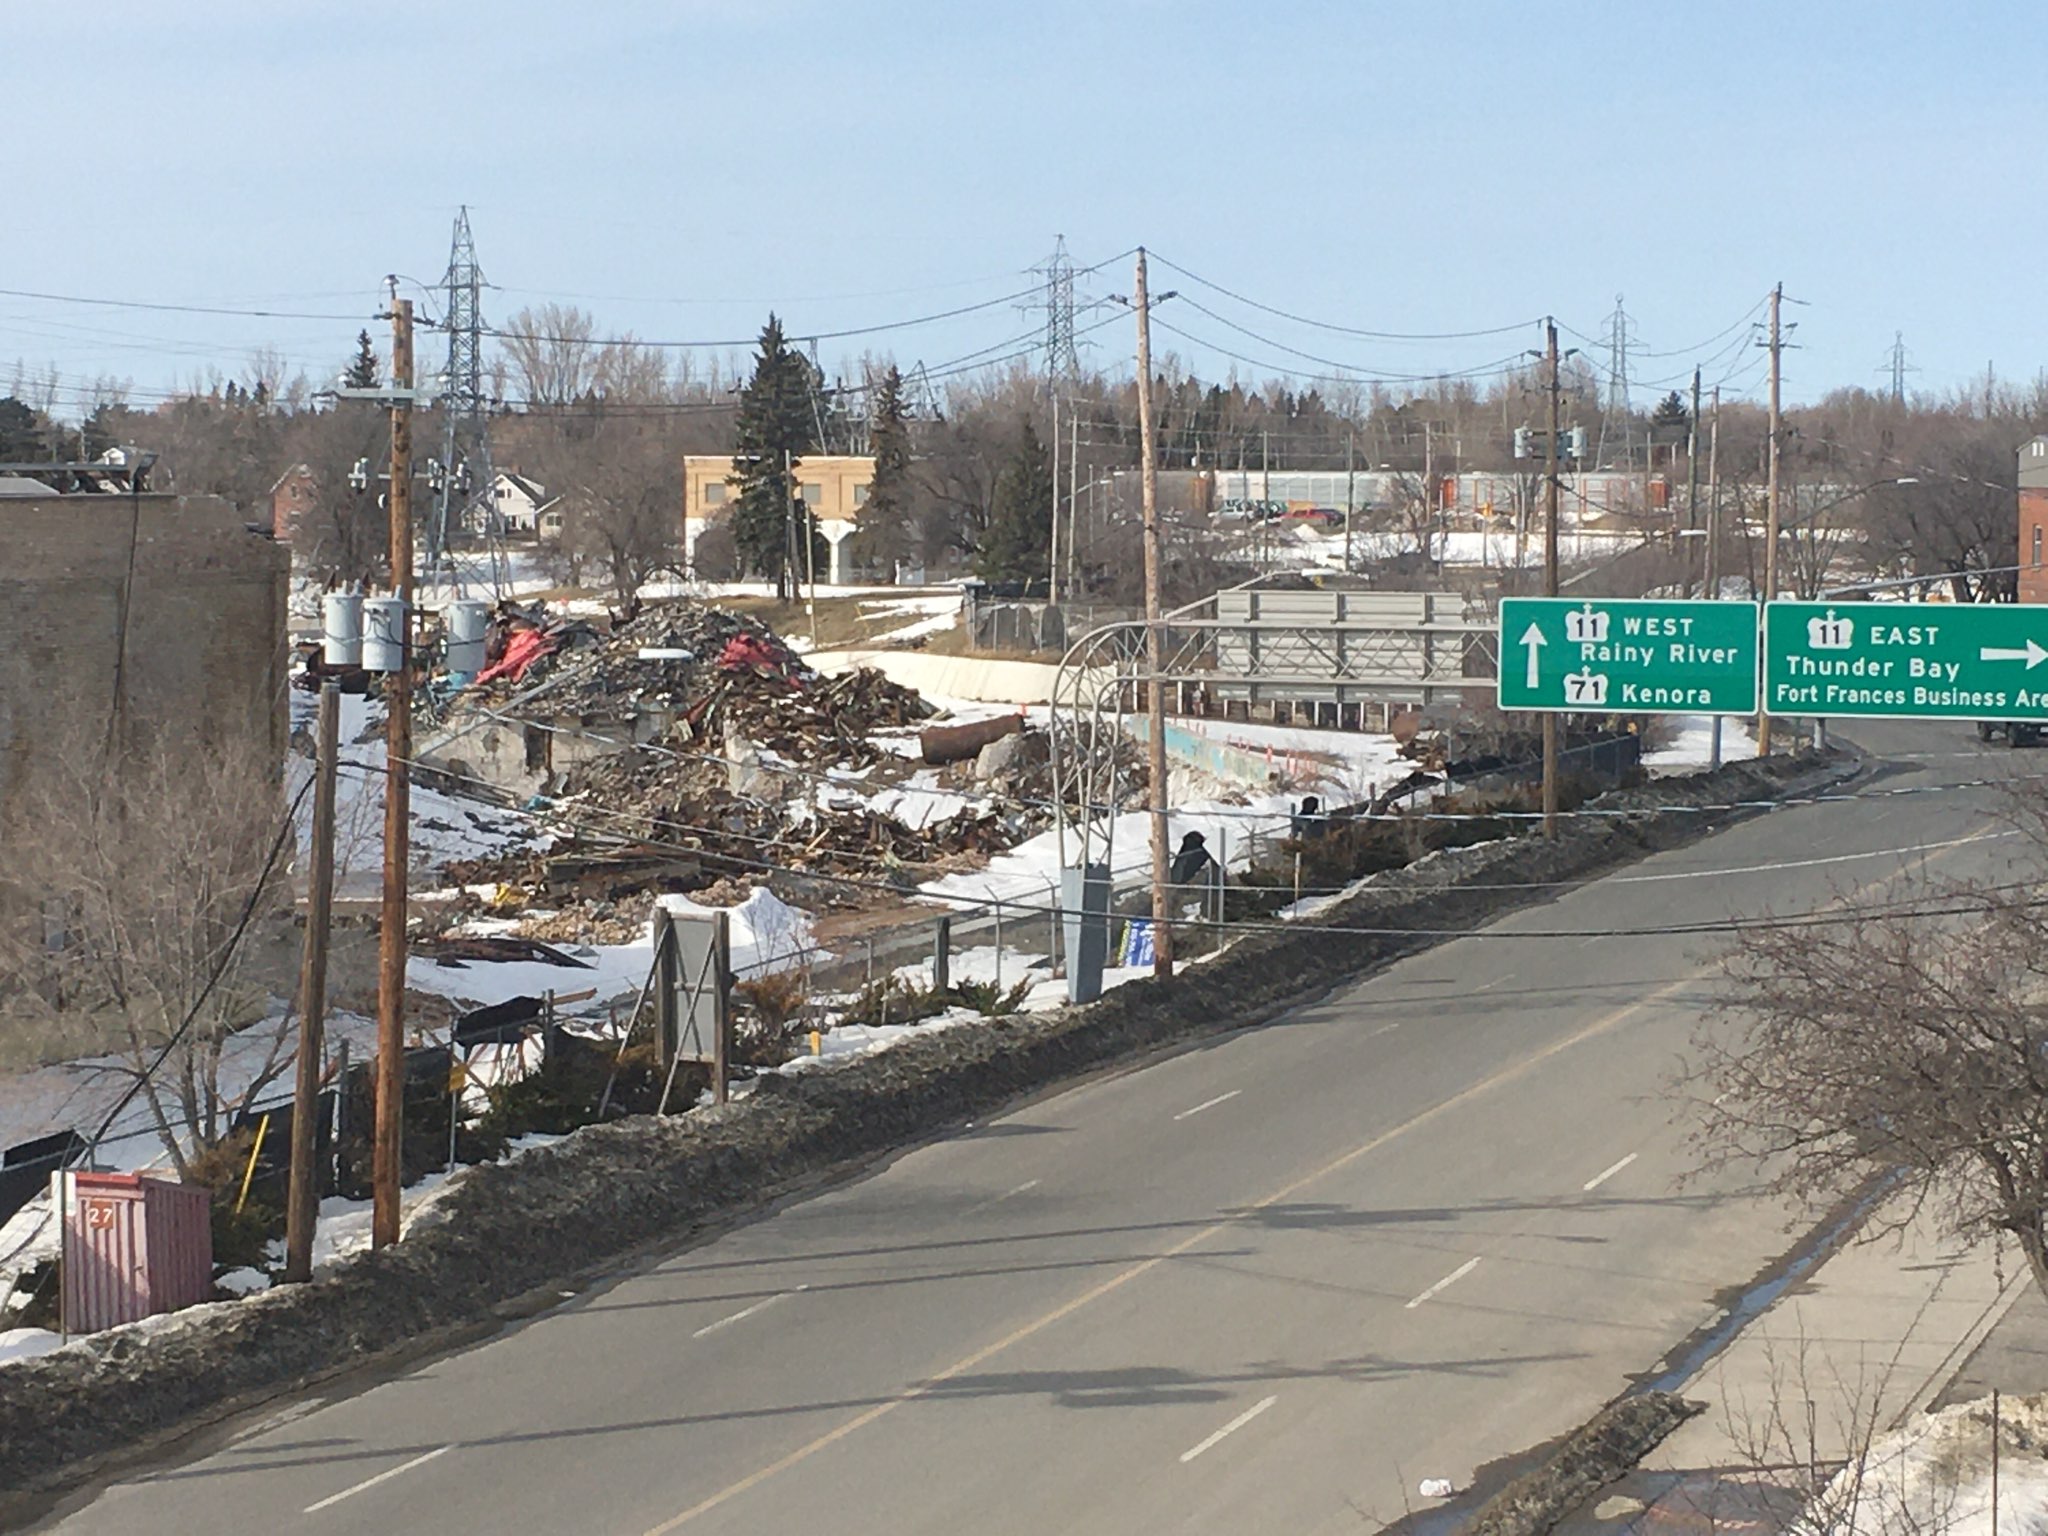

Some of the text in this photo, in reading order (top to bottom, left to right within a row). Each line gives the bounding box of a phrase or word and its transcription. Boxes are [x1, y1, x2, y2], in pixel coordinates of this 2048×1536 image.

[1576, 618, 1694, 638] 11 WEST
[1819, 625, 1940, 645] 11 EAST
[1581, 642, 1738, 667] Rainy River
[1786, 655, 1960, 682] Thunder Bay
[1570, 681, 1712, 704] 71 Kenora
[1777, 684, 1818, 703] Fort
[1826, 685, 1906, 705] Frances
[1914, 687, 2006, 707] Business
[90, 1208, 112, 1223] 27
